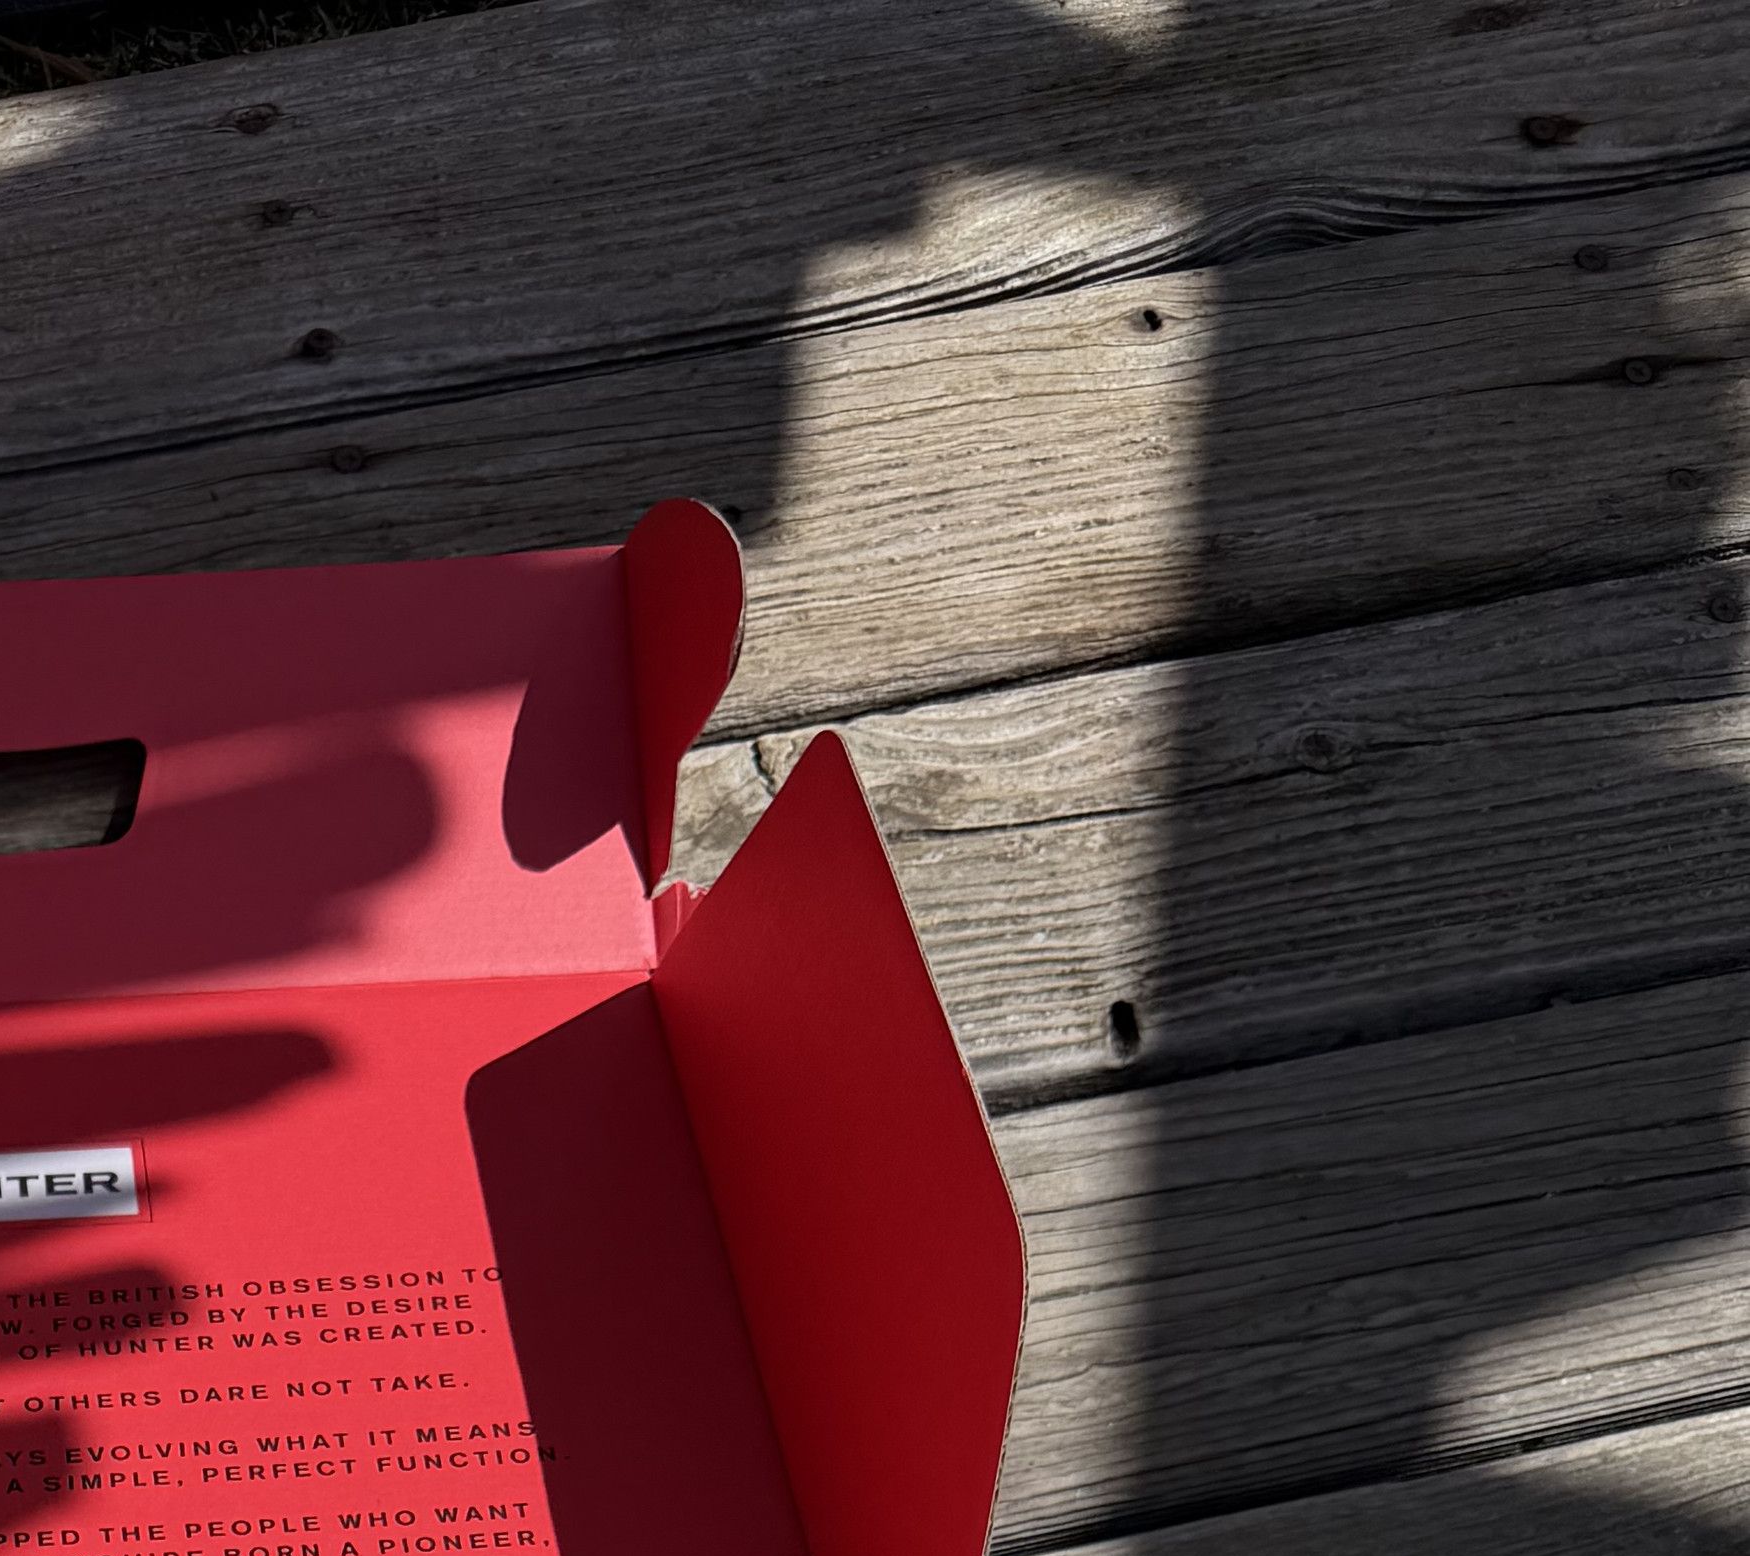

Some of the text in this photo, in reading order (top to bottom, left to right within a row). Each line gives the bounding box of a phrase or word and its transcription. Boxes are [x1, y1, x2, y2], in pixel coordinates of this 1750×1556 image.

[8, 1293, 69, 1309] THE
[89, 1284, 224, 1305] BRITISH
[243, 1271, 444, 1296] OBSESSION
[463, 1268, 503, 1283] TO
[53, 1312, 189, 1333] FORGED
[208, 1308, 246, 1324] BY
[265, 1304, 328, 1321] THE
[347, 1295, 471, 1316] DESIRE
[18, 1345, 60, 1360] OF
[79, 1336, 214, 1357] HUNTER
[233, 1331, 301, 1348] WAS
[320, 1321, 485, 1343] CREATED.
[24, 1391, 161, 1412] OTHERS
[180, 1385, 268, 1404] DARE
[287, 1380, 352, 1397] NOT
[371, 1374, 469, 1392] TAKE.
[66, 1440, 238, 1464] EVOLVING
[257, 1433, 348, 1453] WHAT
[369, 1430, 395, 1446] IT
[416, 1422, 534, 1443] MEANS
[7, 1479, 24, 1494] A
[43, 1471, 183, 1492] SIMPLE,
[202, 1460, 356, 1483] PERFECT
[377, 1448, 571, 1473] FUNCTION.
[99, 1525, 166, 1543] THE
[185, 1517, 320, 1539] PEOPLE
[338, 1511, 416, 1530] WHO
[435, 1503, 528, 1523] WANT
[342, 1542, 359, 1556] A
[379, 1531, 549, 1555] PIONEER,
